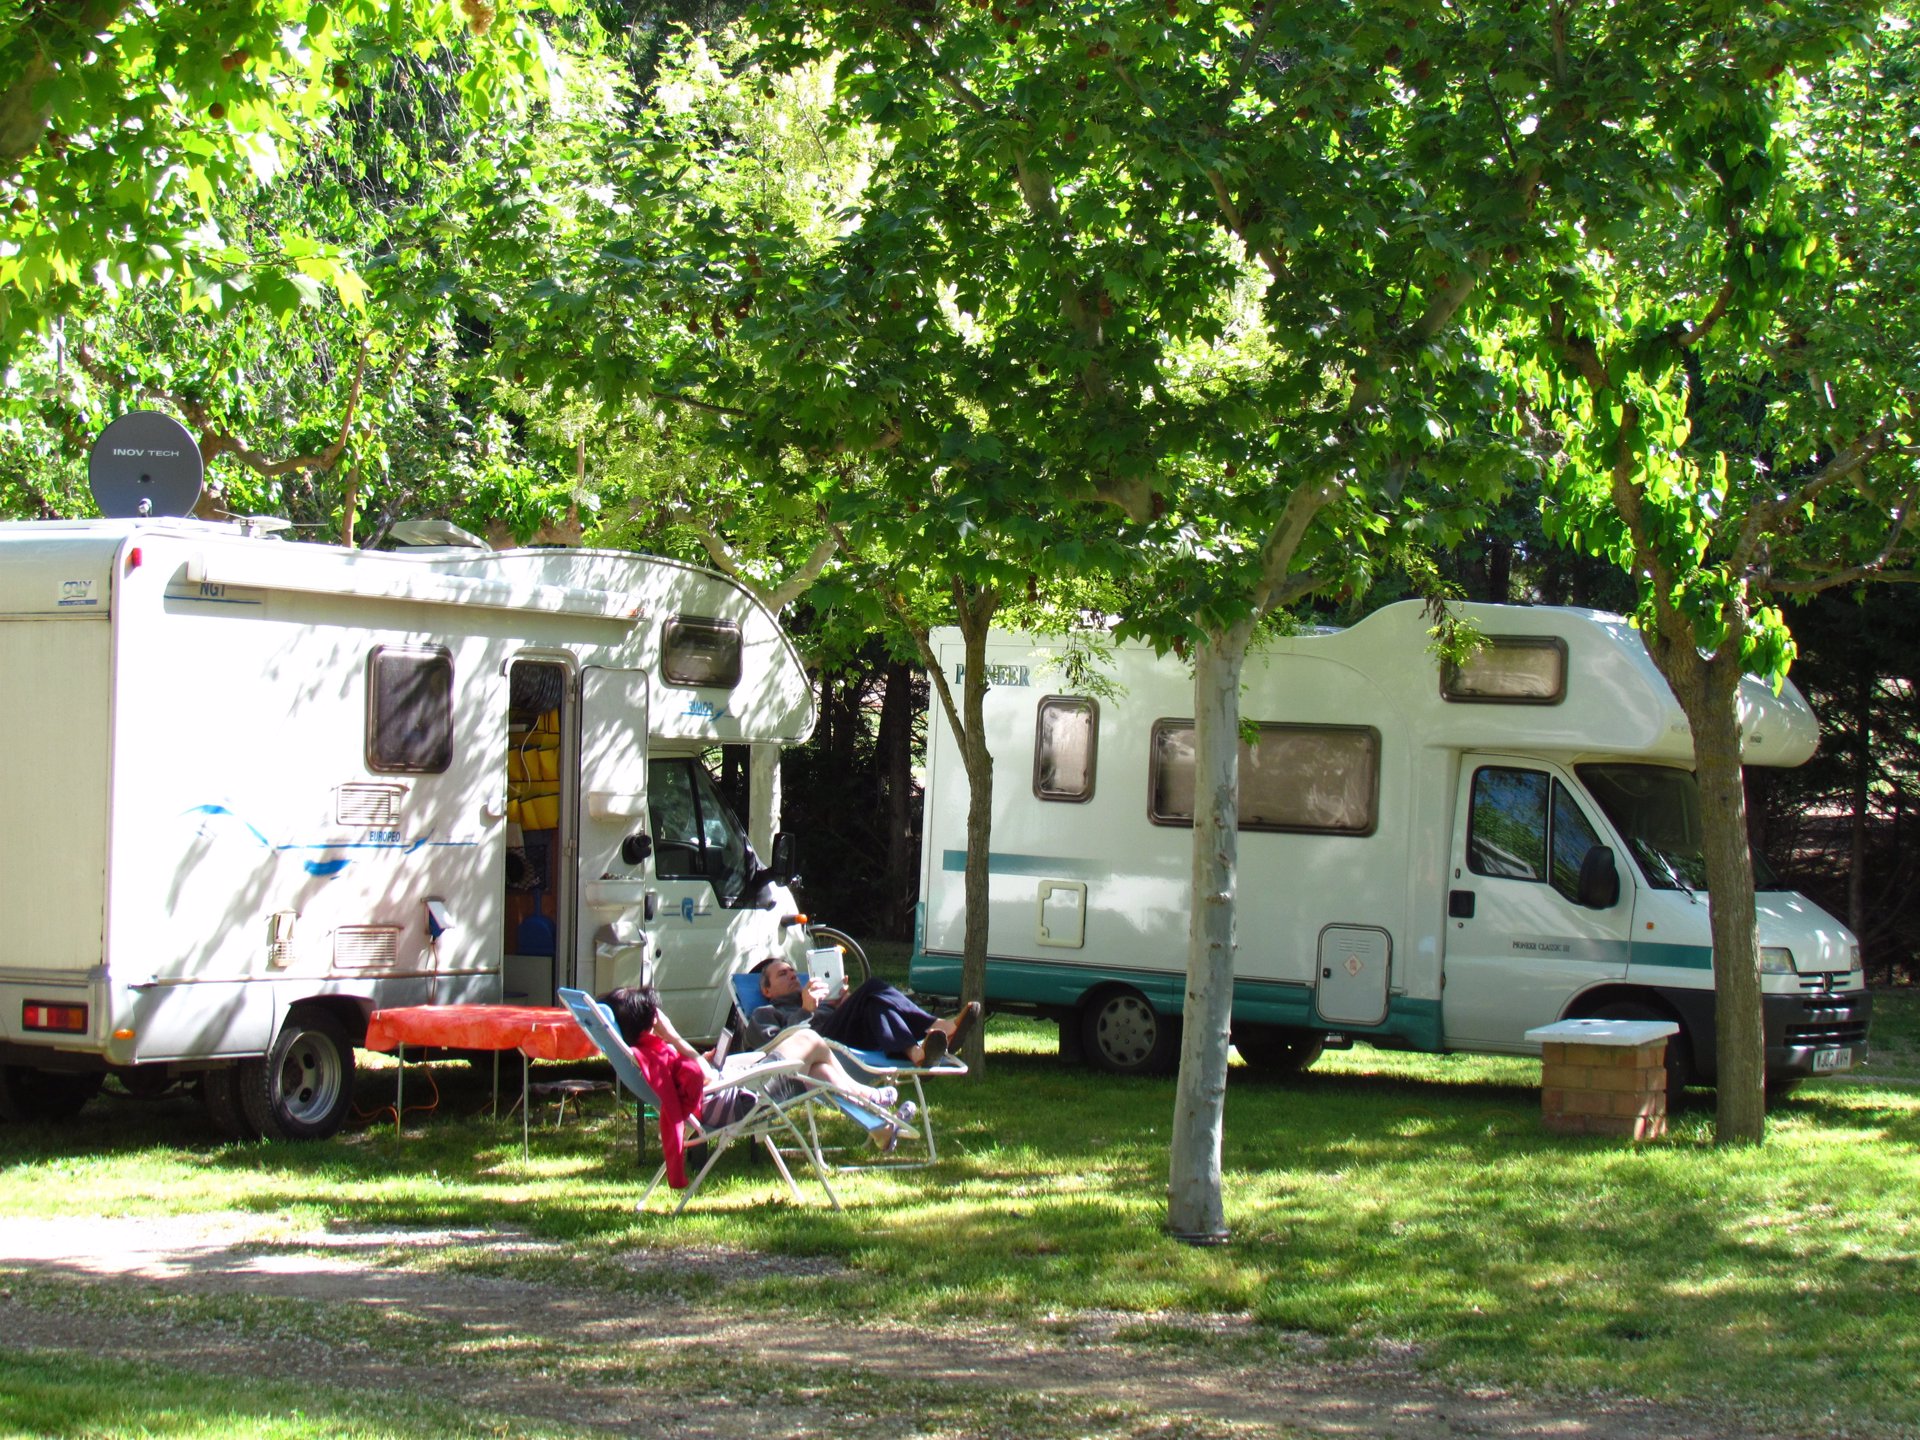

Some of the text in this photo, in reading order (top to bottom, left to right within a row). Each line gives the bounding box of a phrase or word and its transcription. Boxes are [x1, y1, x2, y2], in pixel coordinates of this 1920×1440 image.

[113, 448, 144, 456] INOV
[955, 663, 1030, 687] PNEER
[369, 831, 401, 842] EUROPEO
